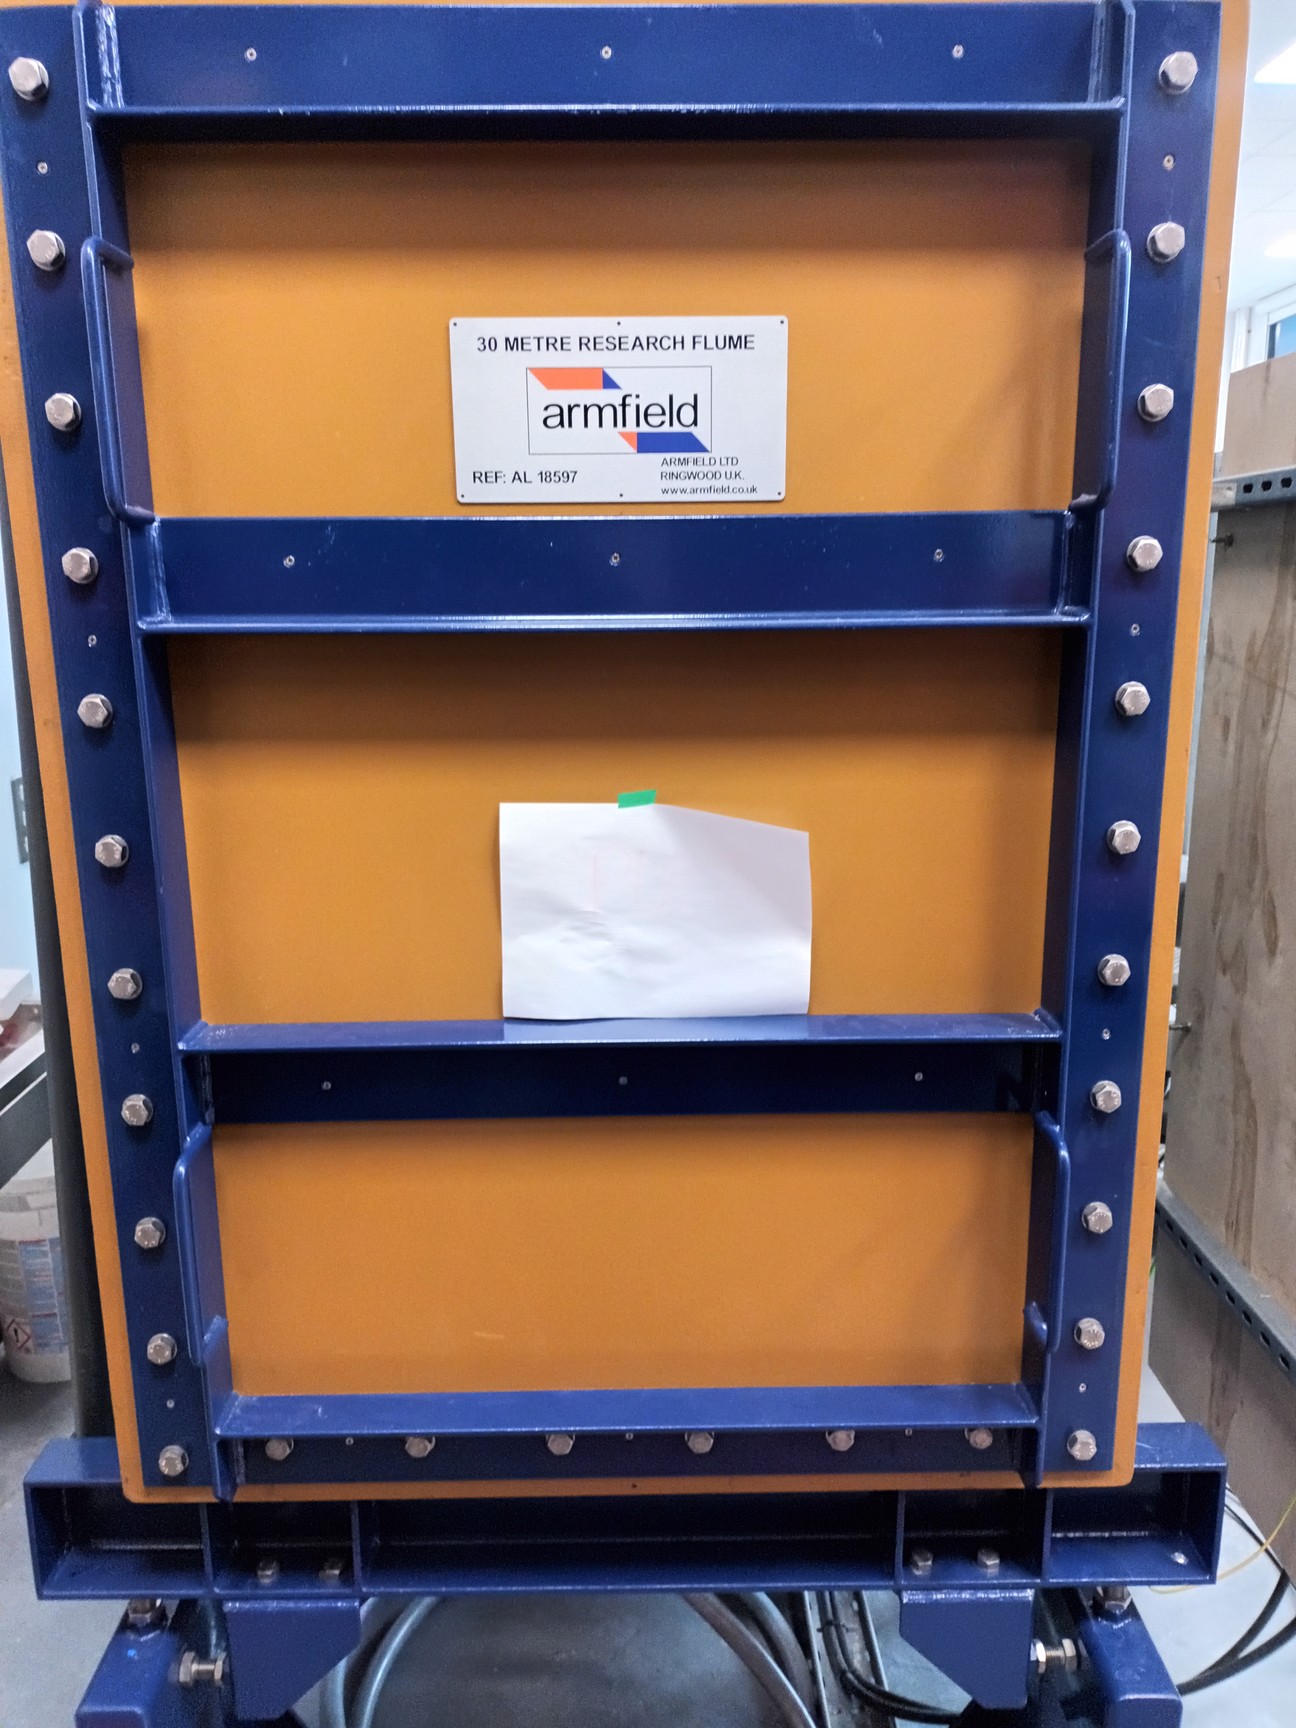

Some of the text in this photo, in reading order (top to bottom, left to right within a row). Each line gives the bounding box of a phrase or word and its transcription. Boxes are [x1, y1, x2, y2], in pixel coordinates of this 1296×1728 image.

[477, 334, 756, 352] 30 METRE RESEARCH FLUME
[542, 393, 698, 429] armfield
[661, 456, 739, 467] ARMFIELD LTD
[472, 470, 578, 485] REF: AL 18597
[660, 469, 745, 481] RINGWOOD U.K.
[660, 484, 758, 495] www.armfield.co.uk
